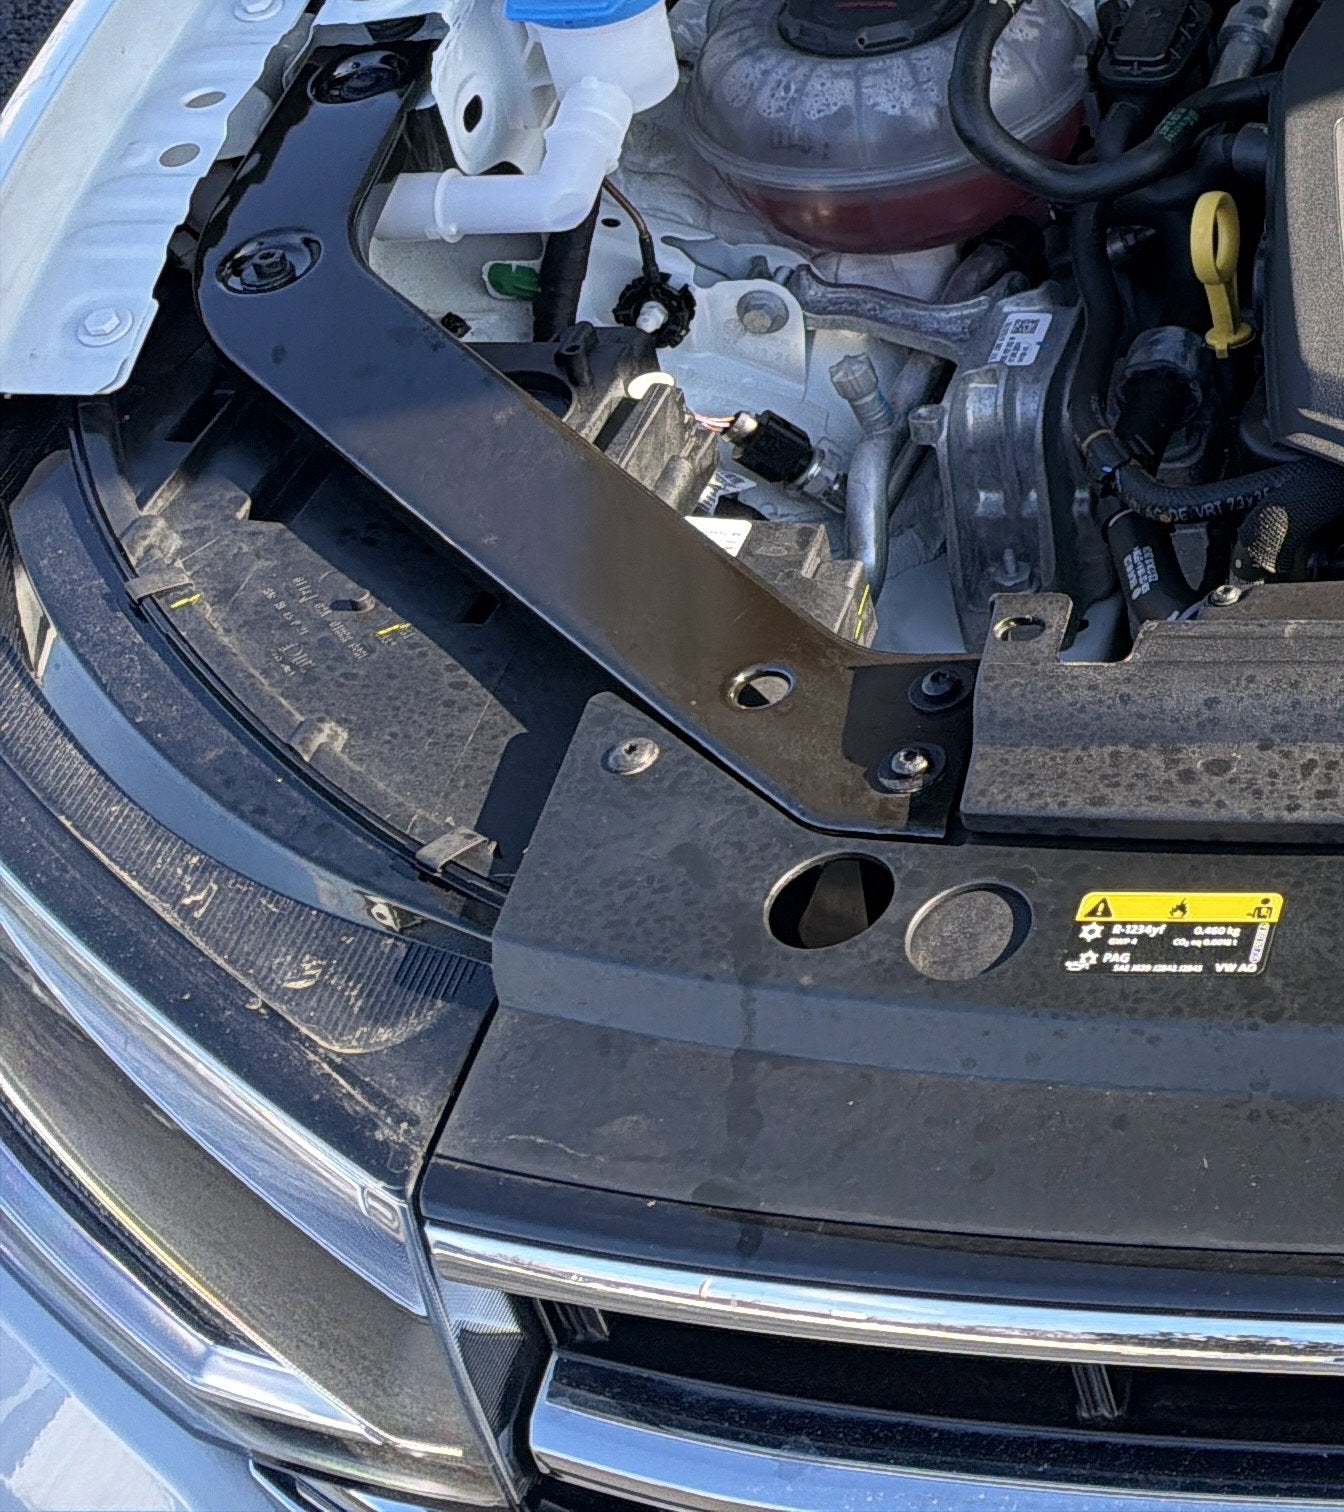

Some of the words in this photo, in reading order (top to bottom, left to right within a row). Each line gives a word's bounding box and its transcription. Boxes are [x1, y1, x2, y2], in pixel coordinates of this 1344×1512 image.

[1111, 924, 1168, 937] R-1234yf
[1226, 926, 1242, 937] kg
[1102, 953, 1131, 963] PAG
[1214, 964, 1235, 972] VW
[1238, 963, 1258, 972] AG
